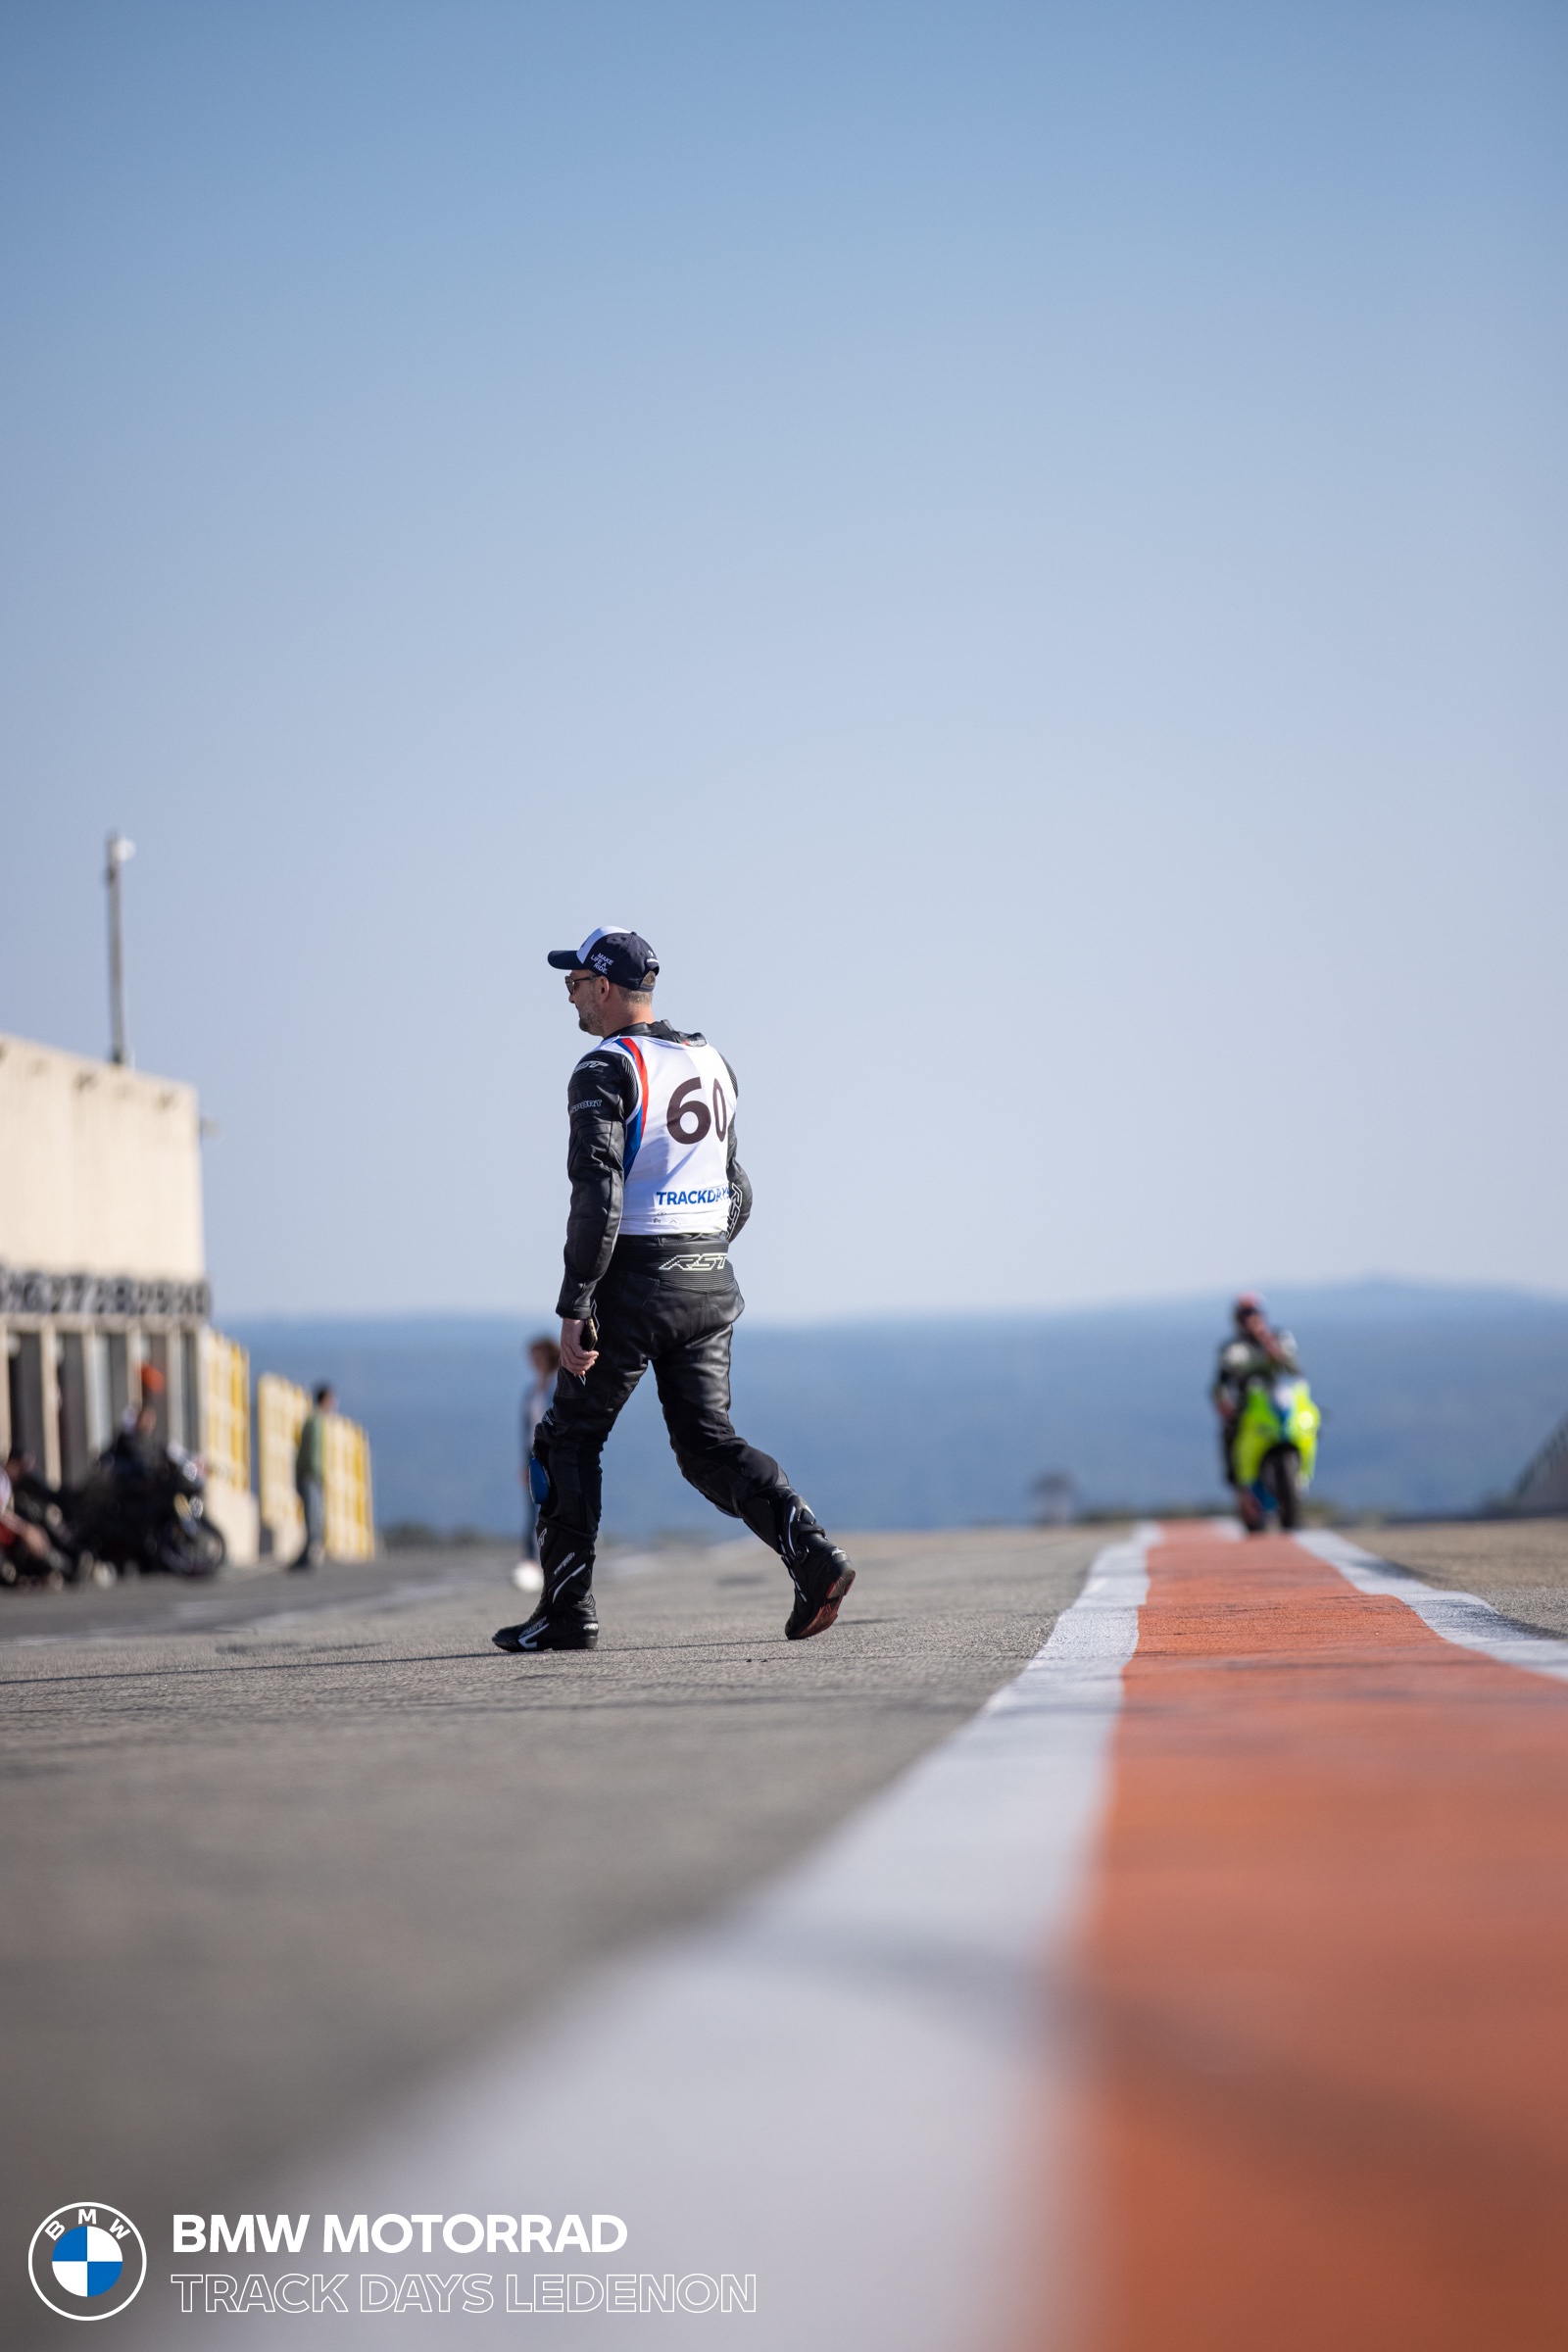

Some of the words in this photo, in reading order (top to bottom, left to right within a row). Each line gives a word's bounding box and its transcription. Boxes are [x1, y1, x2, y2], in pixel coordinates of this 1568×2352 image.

[590, 955, 602, 966] LIFE
[598, 953, 613, 965] MAKE
[666, 1077, 727, 1145] 60
[659, 1253, 728, 1271] RST
